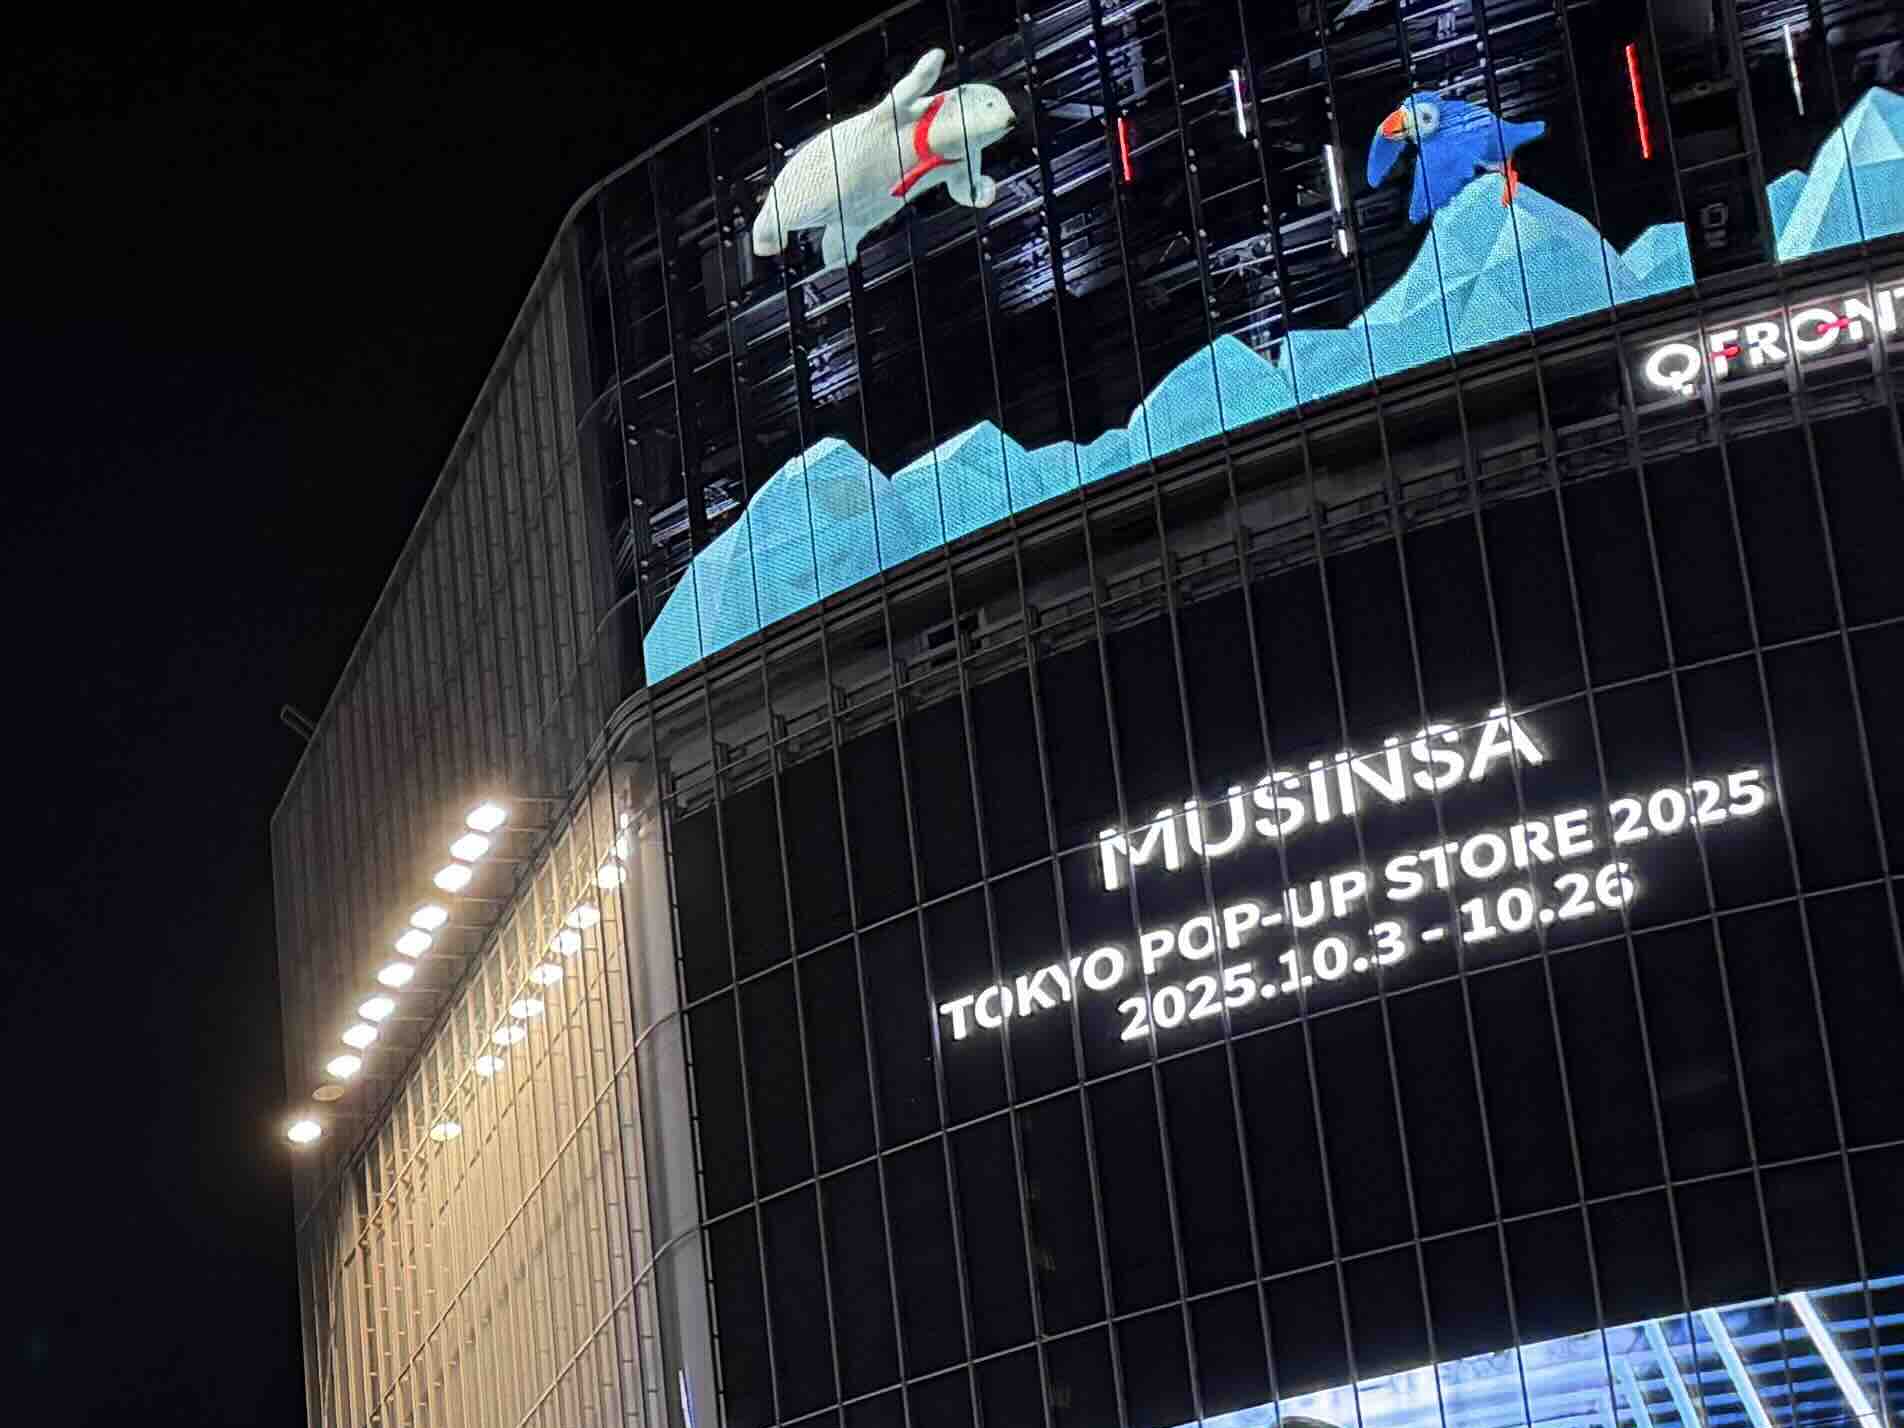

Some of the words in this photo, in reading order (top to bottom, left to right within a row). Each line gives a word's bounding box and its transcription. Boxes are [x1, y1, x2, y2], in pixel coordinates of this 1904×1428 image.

[1096, 702, 1549, 892] MUSINSA
[940, 945, 1125, 1041] TOKYO
[1140, 870, 1369, 978] POP-UP
[1385, 807, 1596, 902] STORE
[1612, 768, 1772, 848] 2025
[1116, 919, 1408, 1043] 2025.10.3
[1459, 860, 1639, 945] 10.26
